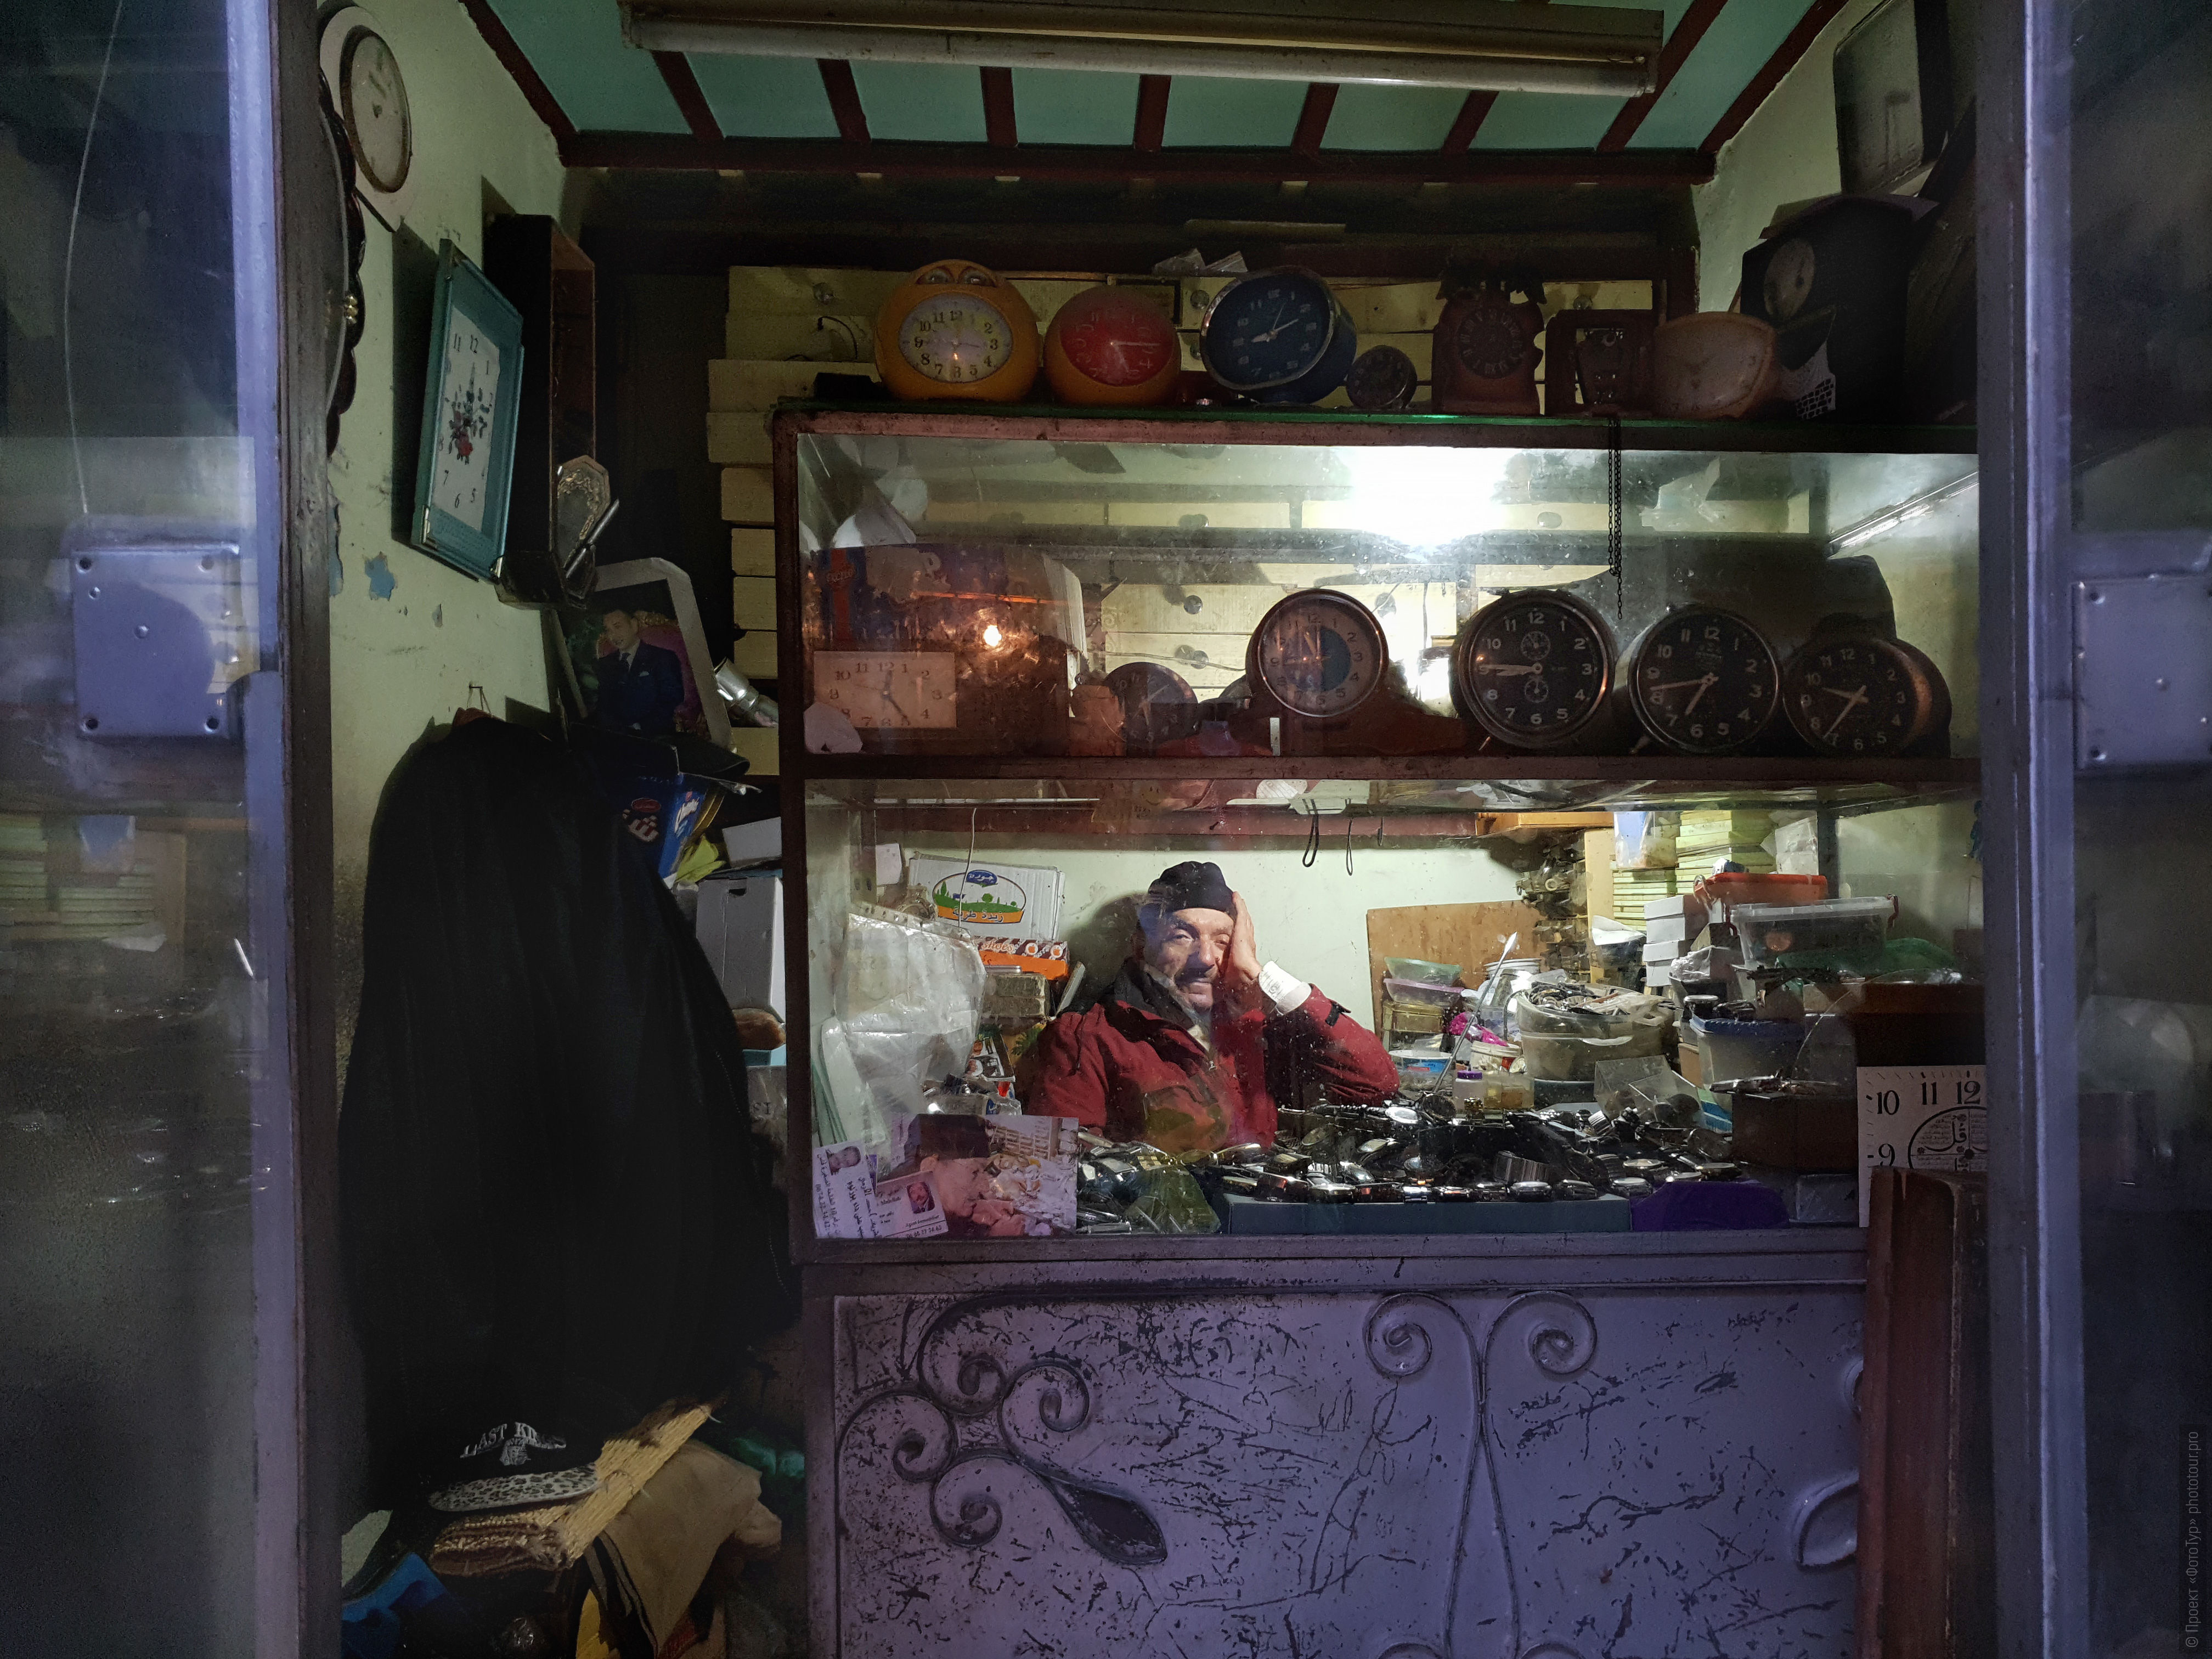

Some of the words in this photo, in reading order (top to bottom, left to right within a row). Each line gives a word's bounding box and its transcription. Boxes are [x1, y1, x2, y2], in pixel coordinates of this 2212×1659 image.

[934, 312, 944, 323] 11
[920, 321, 931, 331] 10
[984, 320, 992, 334] 2
[915, 337, 923, 348] 9
[990, 338, 997, 350] 3
[921, 353, 930, 365] 8
[984, 356, 992, 366] 4
[935, 364, 943, 374] 7
[970, 364, 978, 376] 5
[1529, 612, 1544, 624] 12
[1505, 618, 1516, 633] 11
[1560, 620, 1565, 631] 1
[1347, 633, 1357, 642] 2
[1681, 629, 1691, 643] 11
[1705, 626, 1720, 641] 12
[1483, 637, 1502, 650] 10
[1574, 638, 1585, 650] 2
[1734, 638, 1739, 651] 1
[1353, 652, 1363, 662] 3
[1657, 644, 1672, 658] 10
[1839, 648, 1855, 661] 12
[1869, 653, 1876, 665] 1
[856, 663, 870, 673] 11
[878, 662, 894, 672] 12
[902, 664, 909, 673] 1
[1582, 663, 1592, 675] 3
[1647, 666, 1660, 679] 9
[1746, 659, 1758, 674] 2
[835, 670, 851, 681] 10
[921, 670, 930, 680] 2
[1805, 673, 1821, 685] 10
[1886, 669, 1897, 682] 2
[830, 689, 839, 699] 9
[1487, 689, 1498, 700] 8
[1575, 689, 1585, 701] 4
[1749, 684, 1762, 698] 3
[1649, 691, 1663, 706] 8
[1801, 693, 1812, 708] 9
[1896, 691, 1906, 704] 3
[921, 709, 930, 719] 4
[1505, 708, 1515, 719] 7
[1530, 713, 1543, 724] 6
[1556, 708, 1568, 719] 5
[1737, 708, 1751, 721] 4
[861, 716, 873, 727] 7
[1666, 714, 1679, 727] 7
[1892, 714, 1902, 726] 4
[1690, 724, 1704, 738] 6
[1876, 731, 1887, 744] 5
[1853, 738, 1864, 751] 6
[981, 909, 1003, 923] زبدة
[981, 938, 1014, 952] shoes
[1922, 1082, 1937, 1105] 11
[1956, 1080, 1980, 1104] 12
[1877, 1090, 1900, 1115] 10
[460, 1423, 508, 1459] LAST
